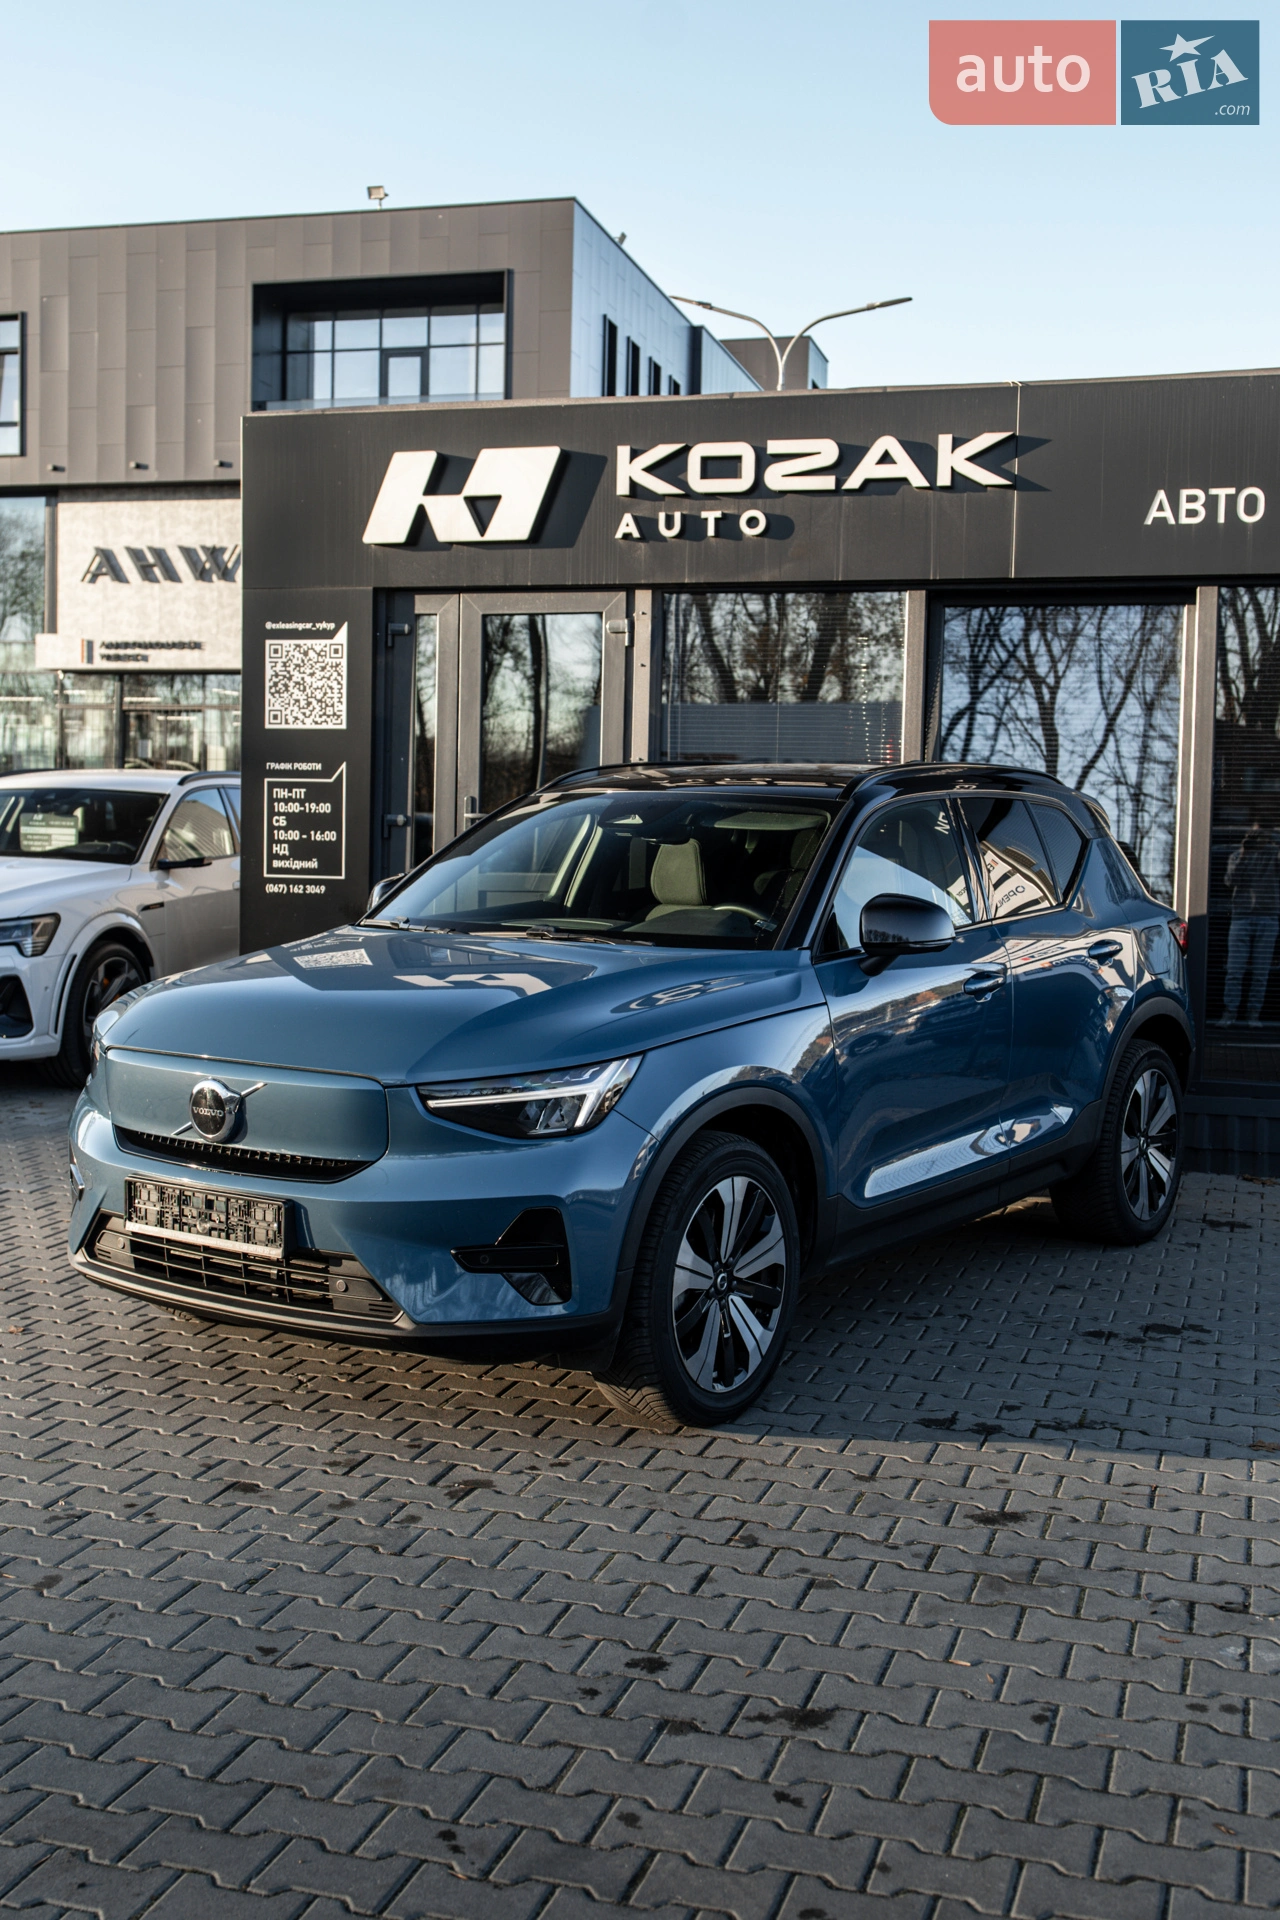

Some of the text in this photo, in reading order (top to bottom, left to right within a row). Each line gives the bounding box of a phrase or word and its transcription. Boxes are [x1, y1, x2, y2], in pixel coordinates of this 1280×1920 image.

[616, 432, 1014, 497] KOZAK
[1143, 486, 1266, 525] АВТО
[614, 509, 767, 540] AUTO
[266, 762, 322, 771] ГРАФІК РОБОТИ
[272, 788, 307, 799] ПН-ПТ
[273, 802, 332, 813] 10:00-19:00
[272, 815, 287, 827] СБ
[273, 829, 300, 841] 10:00
[310, 830, 337, 842] 16:00
[272, 843, 289, 856] НД
[272, 858, 319, 870] вихідний
[265, 883, 326, 895] (067) 162 3049
[192, 1106, 224, 1117] VOLVO
